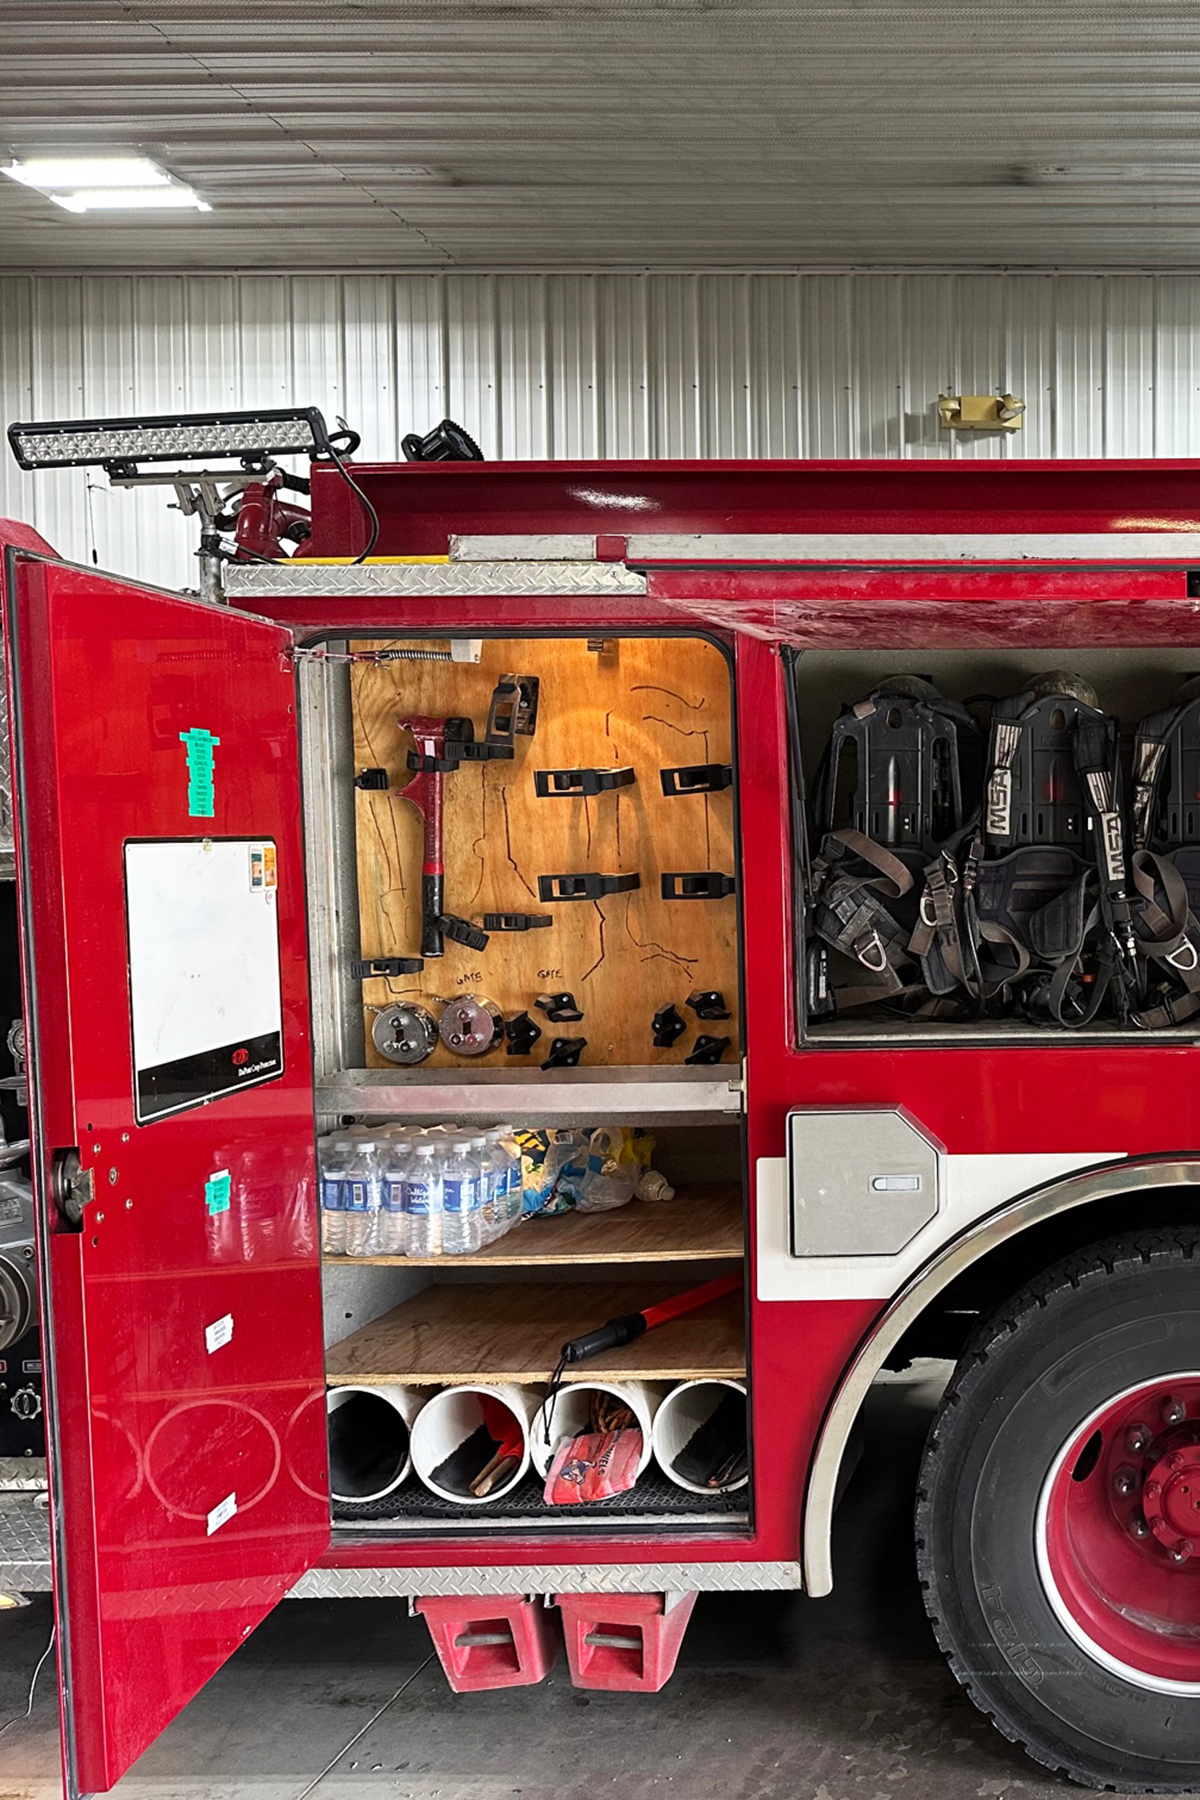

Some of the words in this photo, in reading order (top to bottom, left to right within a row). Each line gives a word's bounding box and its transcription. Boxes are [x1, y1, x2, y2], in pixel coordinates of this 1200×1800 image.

[989, 769, 1010, 832] MSA
[1105, 812, 1125, 876] MSA
[980, 1582, 1045, 1687] G124
